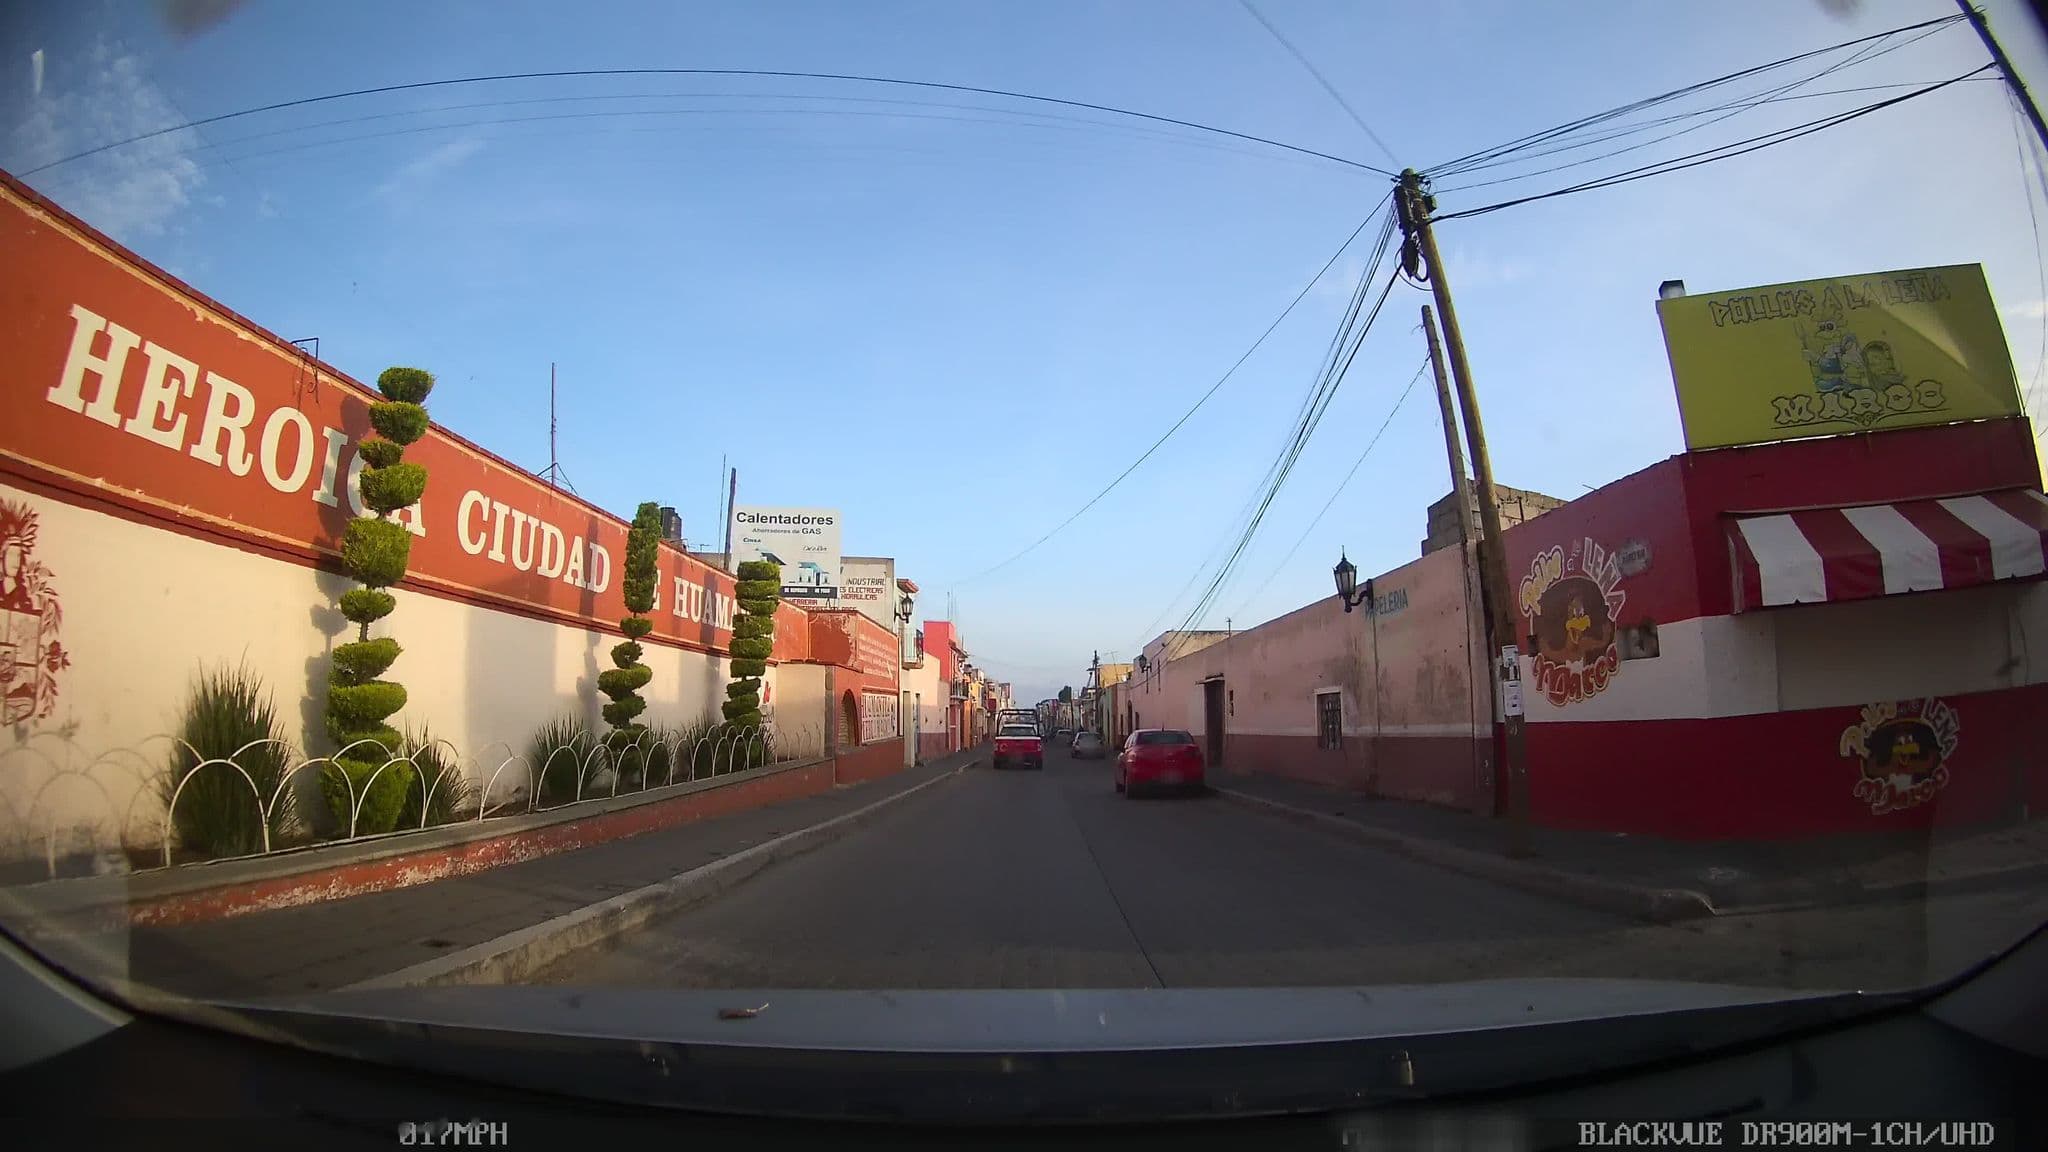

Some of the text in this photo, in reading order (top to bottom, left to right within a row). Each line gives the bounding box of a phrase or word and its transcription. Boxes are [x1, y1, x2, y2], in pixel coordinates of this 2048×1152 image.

[1708, 288, 1816, 327] POLLOS
[1823, 286, 1843, 312] A
[1843, 281, 1882, 311] LA
[1771, 379, 1946, 425] MARCO
[457, 489, 611, 595] CIUDAD
[736, 511, 834, 527] Calentadores
[801, 527, 822, 536] GAS
